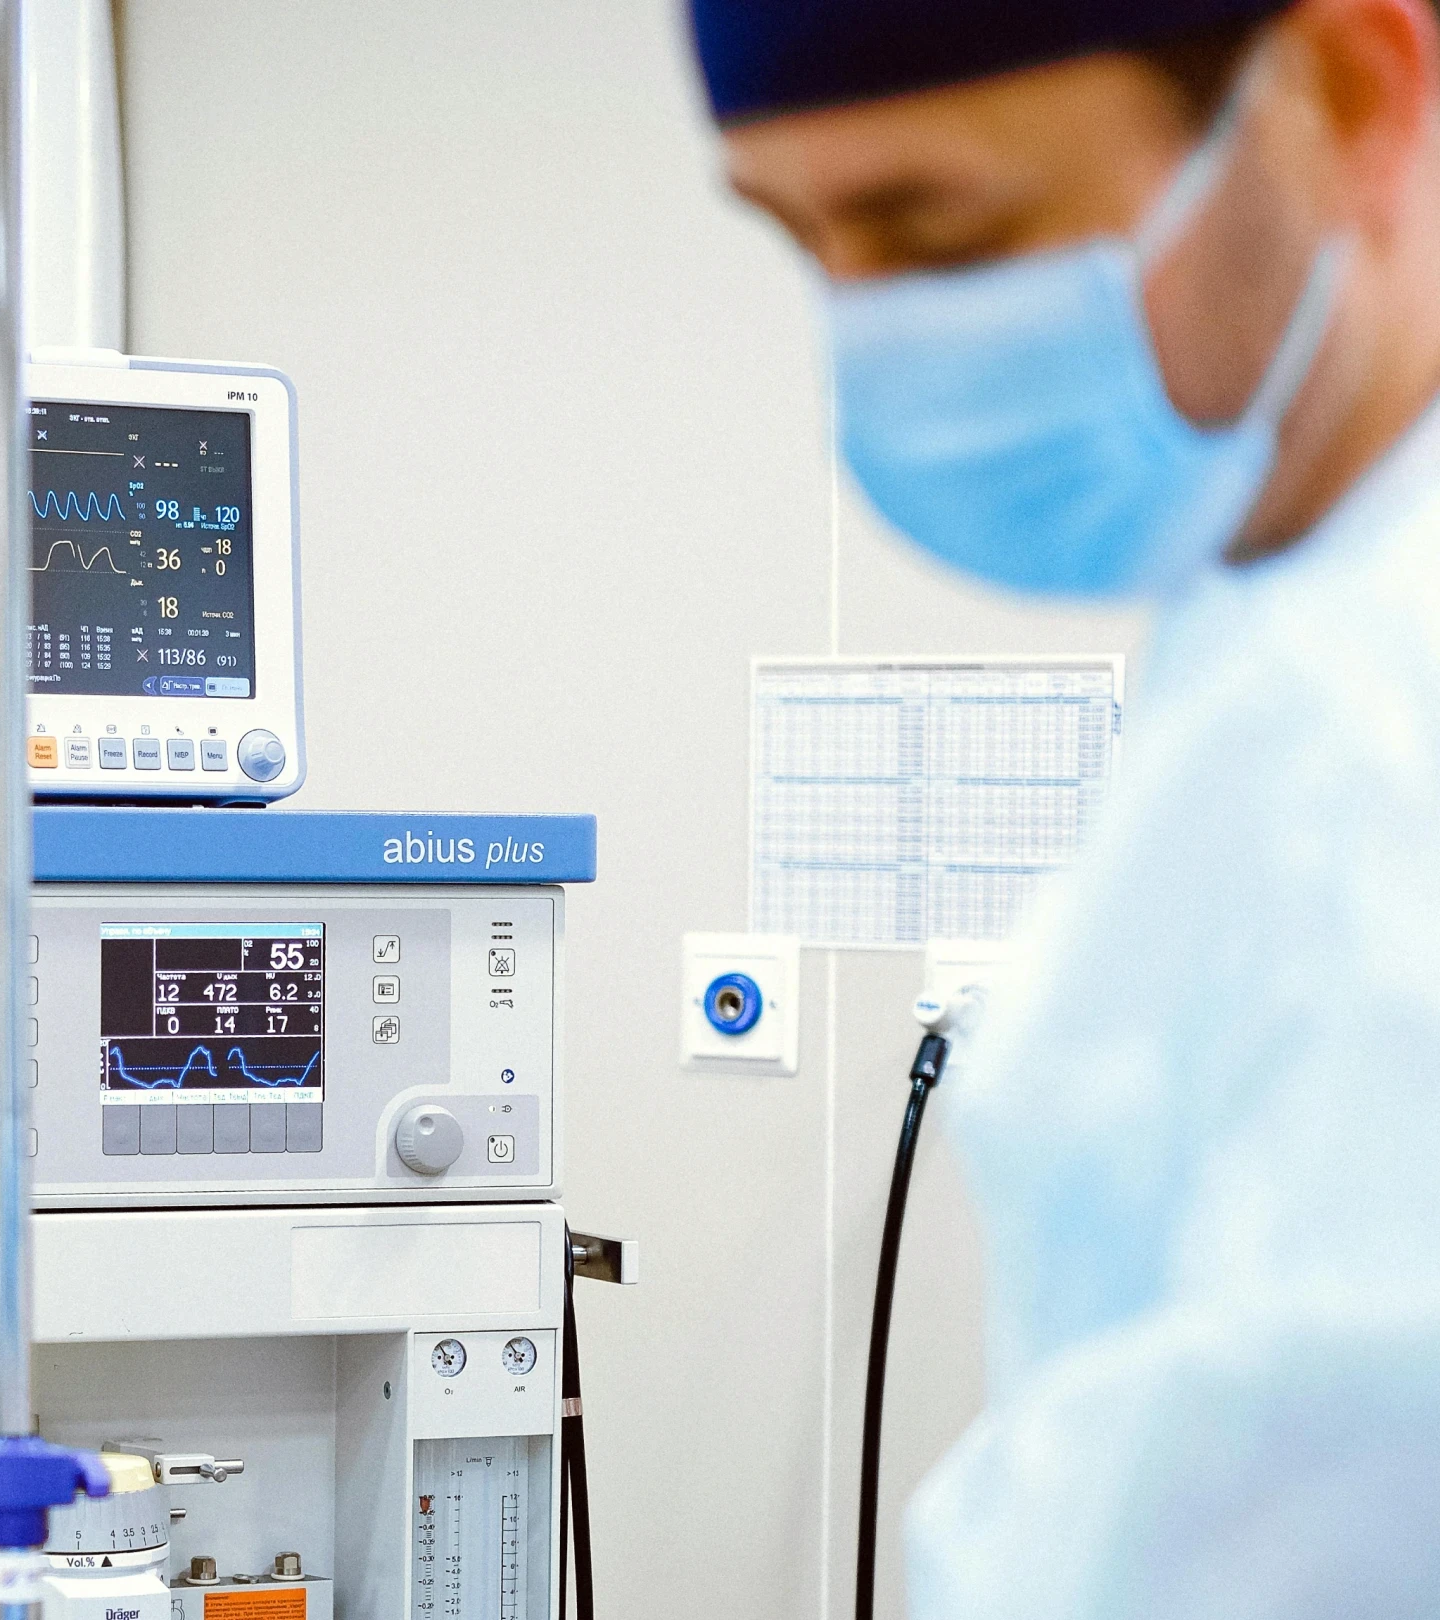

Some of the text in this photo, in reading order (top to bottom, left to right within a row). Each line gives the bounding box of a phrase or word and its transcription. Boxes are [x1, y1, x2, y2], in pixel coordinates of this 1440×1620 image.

[227, 391, 258, 401] iPM 10
[156, 500, 180, 520] 98
[215, 506, 240, 523] 120
[216, 538, 232, 555] 18
[156, 548, 180, 570] 36
[216, 560, 226, 576] 0
[158, 596, 178, 618] 18
[158, 648, 237, 666] 113/86 (91)
[104, 750, 123, 758] Freeze
[383, 830, 545, 870] abius plus
[269, 943, 304, 970] 55
[158, 984, 180, 1002] 12
[203, 984, 237, 1001] 472
[269, 984, 298, 1000] 6.2
[168, 1016, 180, 1034] 0
[214, 1016, 236, 1034] 14
[266, 1016, 288, 1034] 17
[76, 1530, 82, 1540] 5
[110, 1530, 116, 1538] 4
[123, 1528, 135, 1538] 3.5
[141, 1526, 146, 1536] 3
[66, 1556, 95, 1568] Vol.%
[106, 1608, 140, 1620] Dräger
